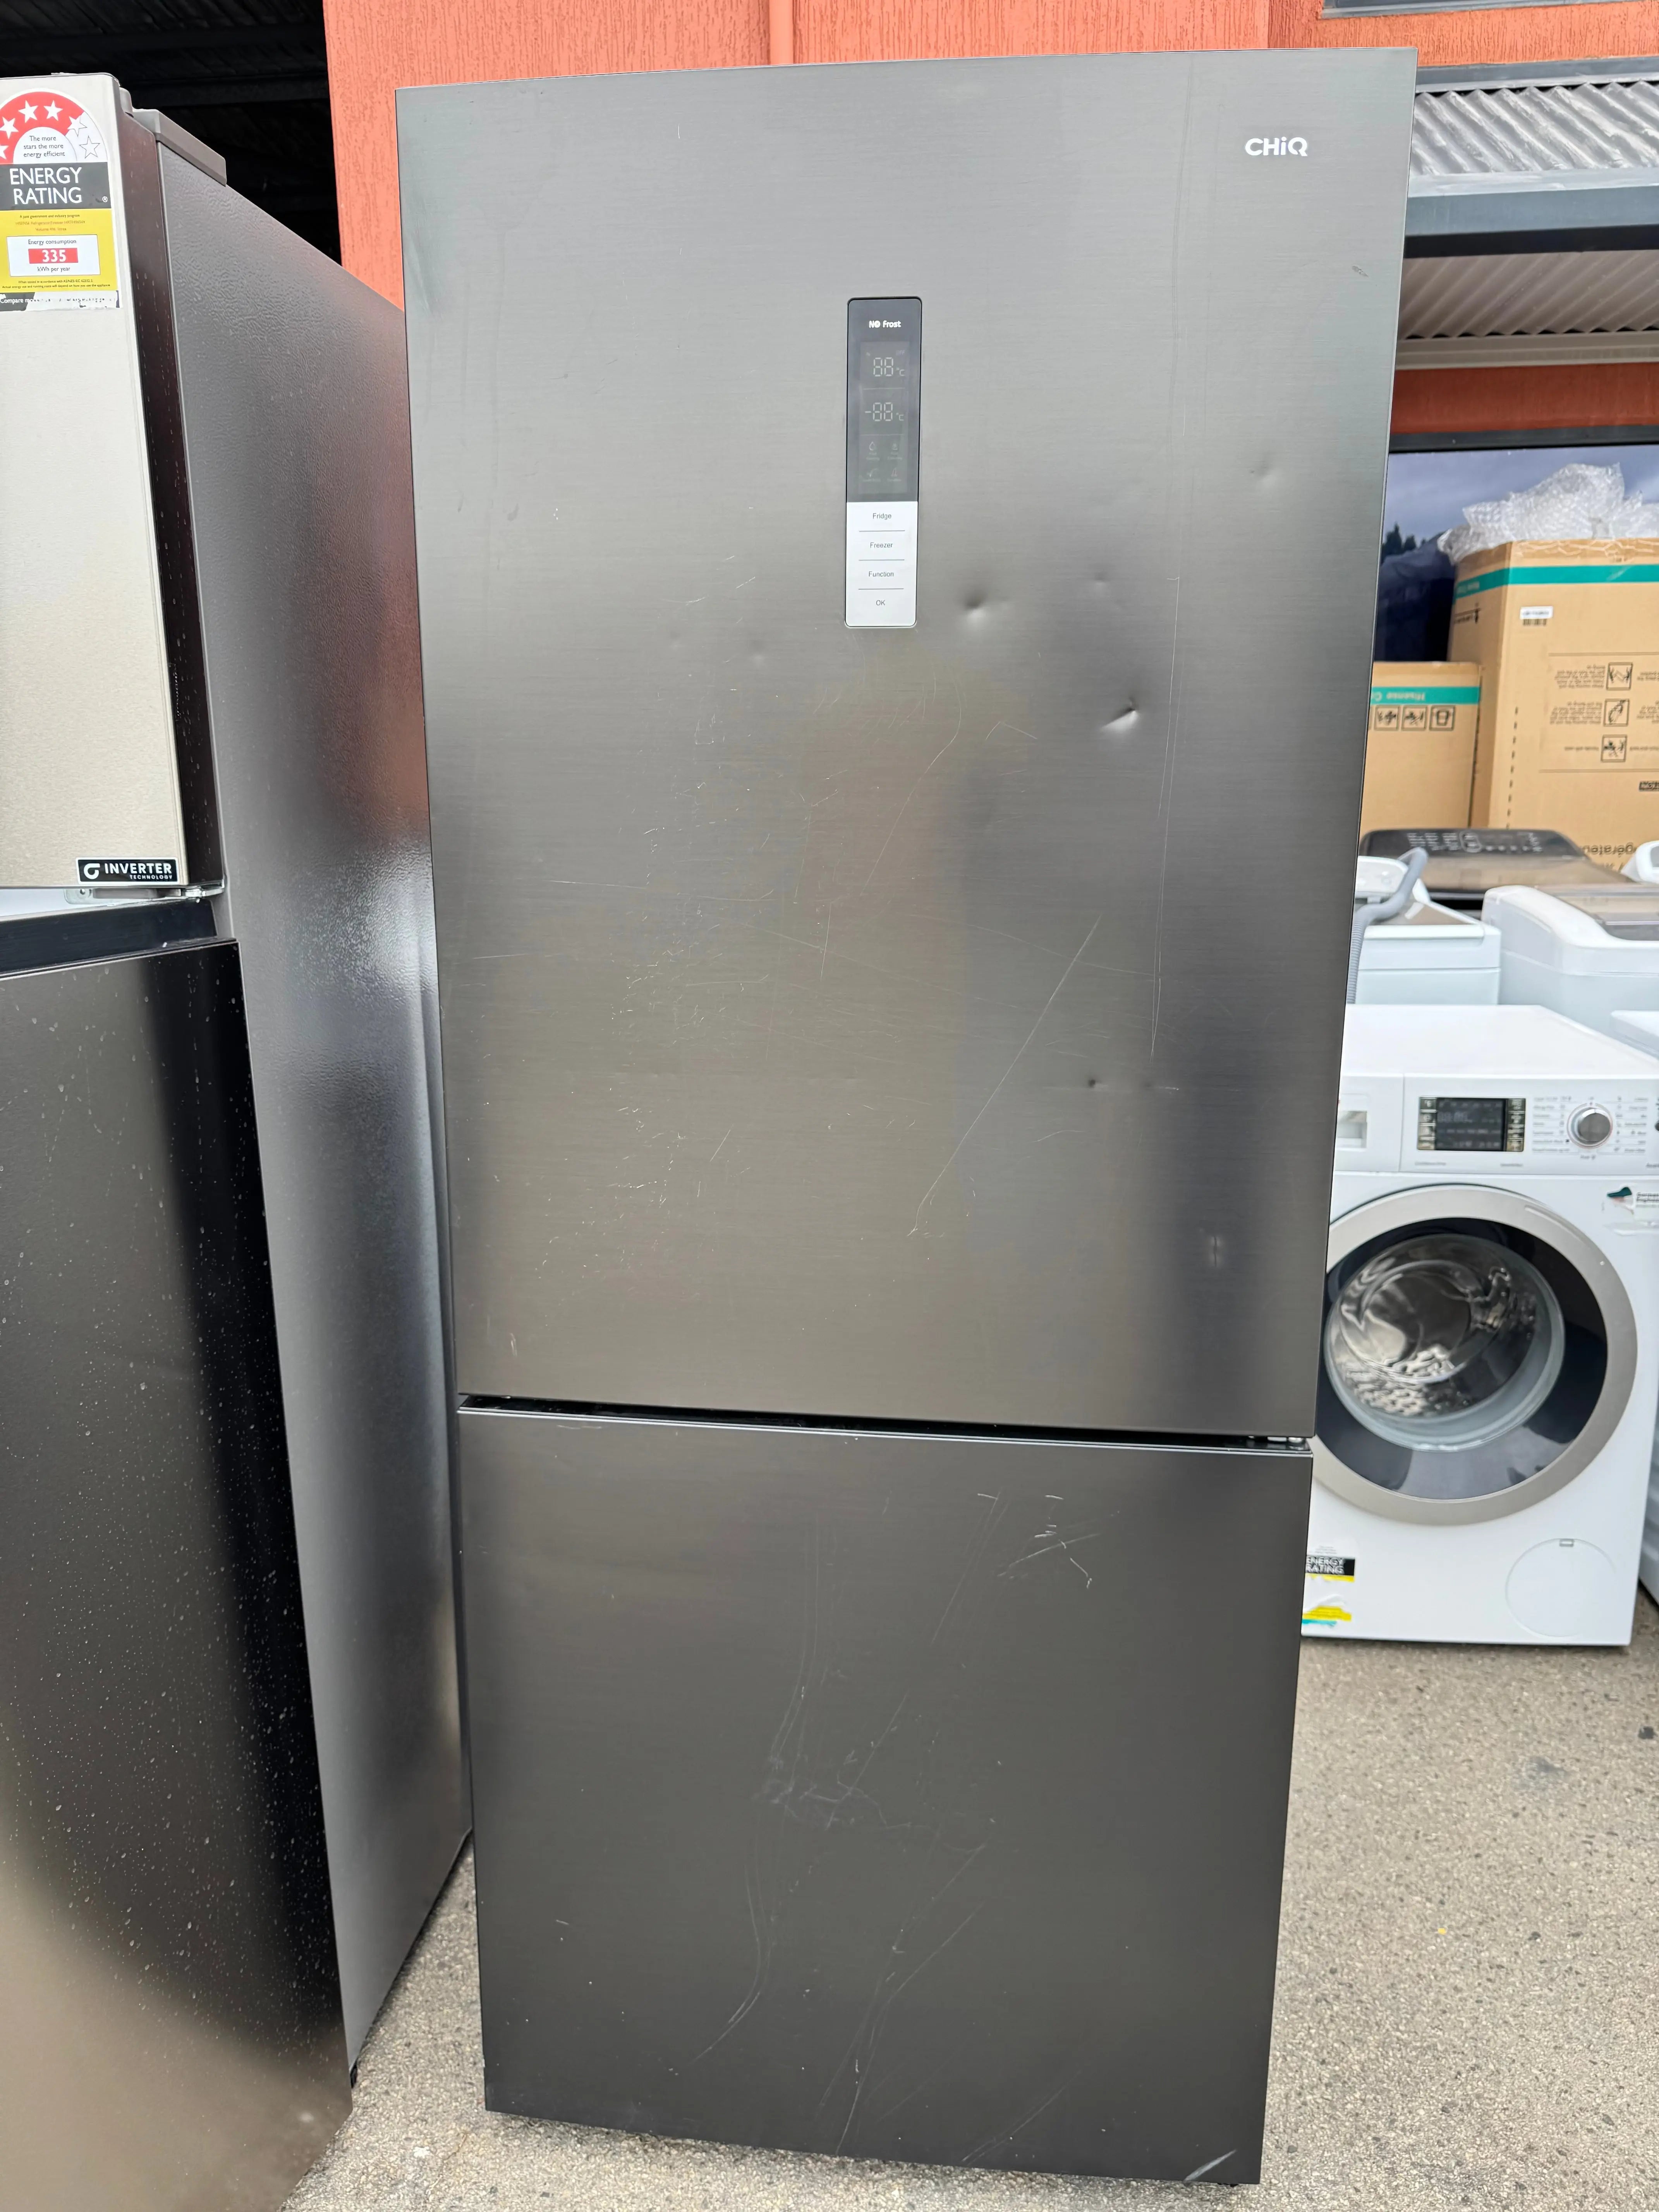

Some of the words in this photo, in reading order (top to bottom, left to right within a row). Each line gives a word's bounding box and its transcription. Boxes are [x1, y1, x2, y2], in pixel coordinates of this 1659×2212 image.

[1245, 136, 1308, 156] CHiQ
[10, 167, 82, 185] ENERGY
[13, 187, 82, 204] RATING
[42, 249, 67, 262] 335
[105, 863, 172, 874] INVERTER
